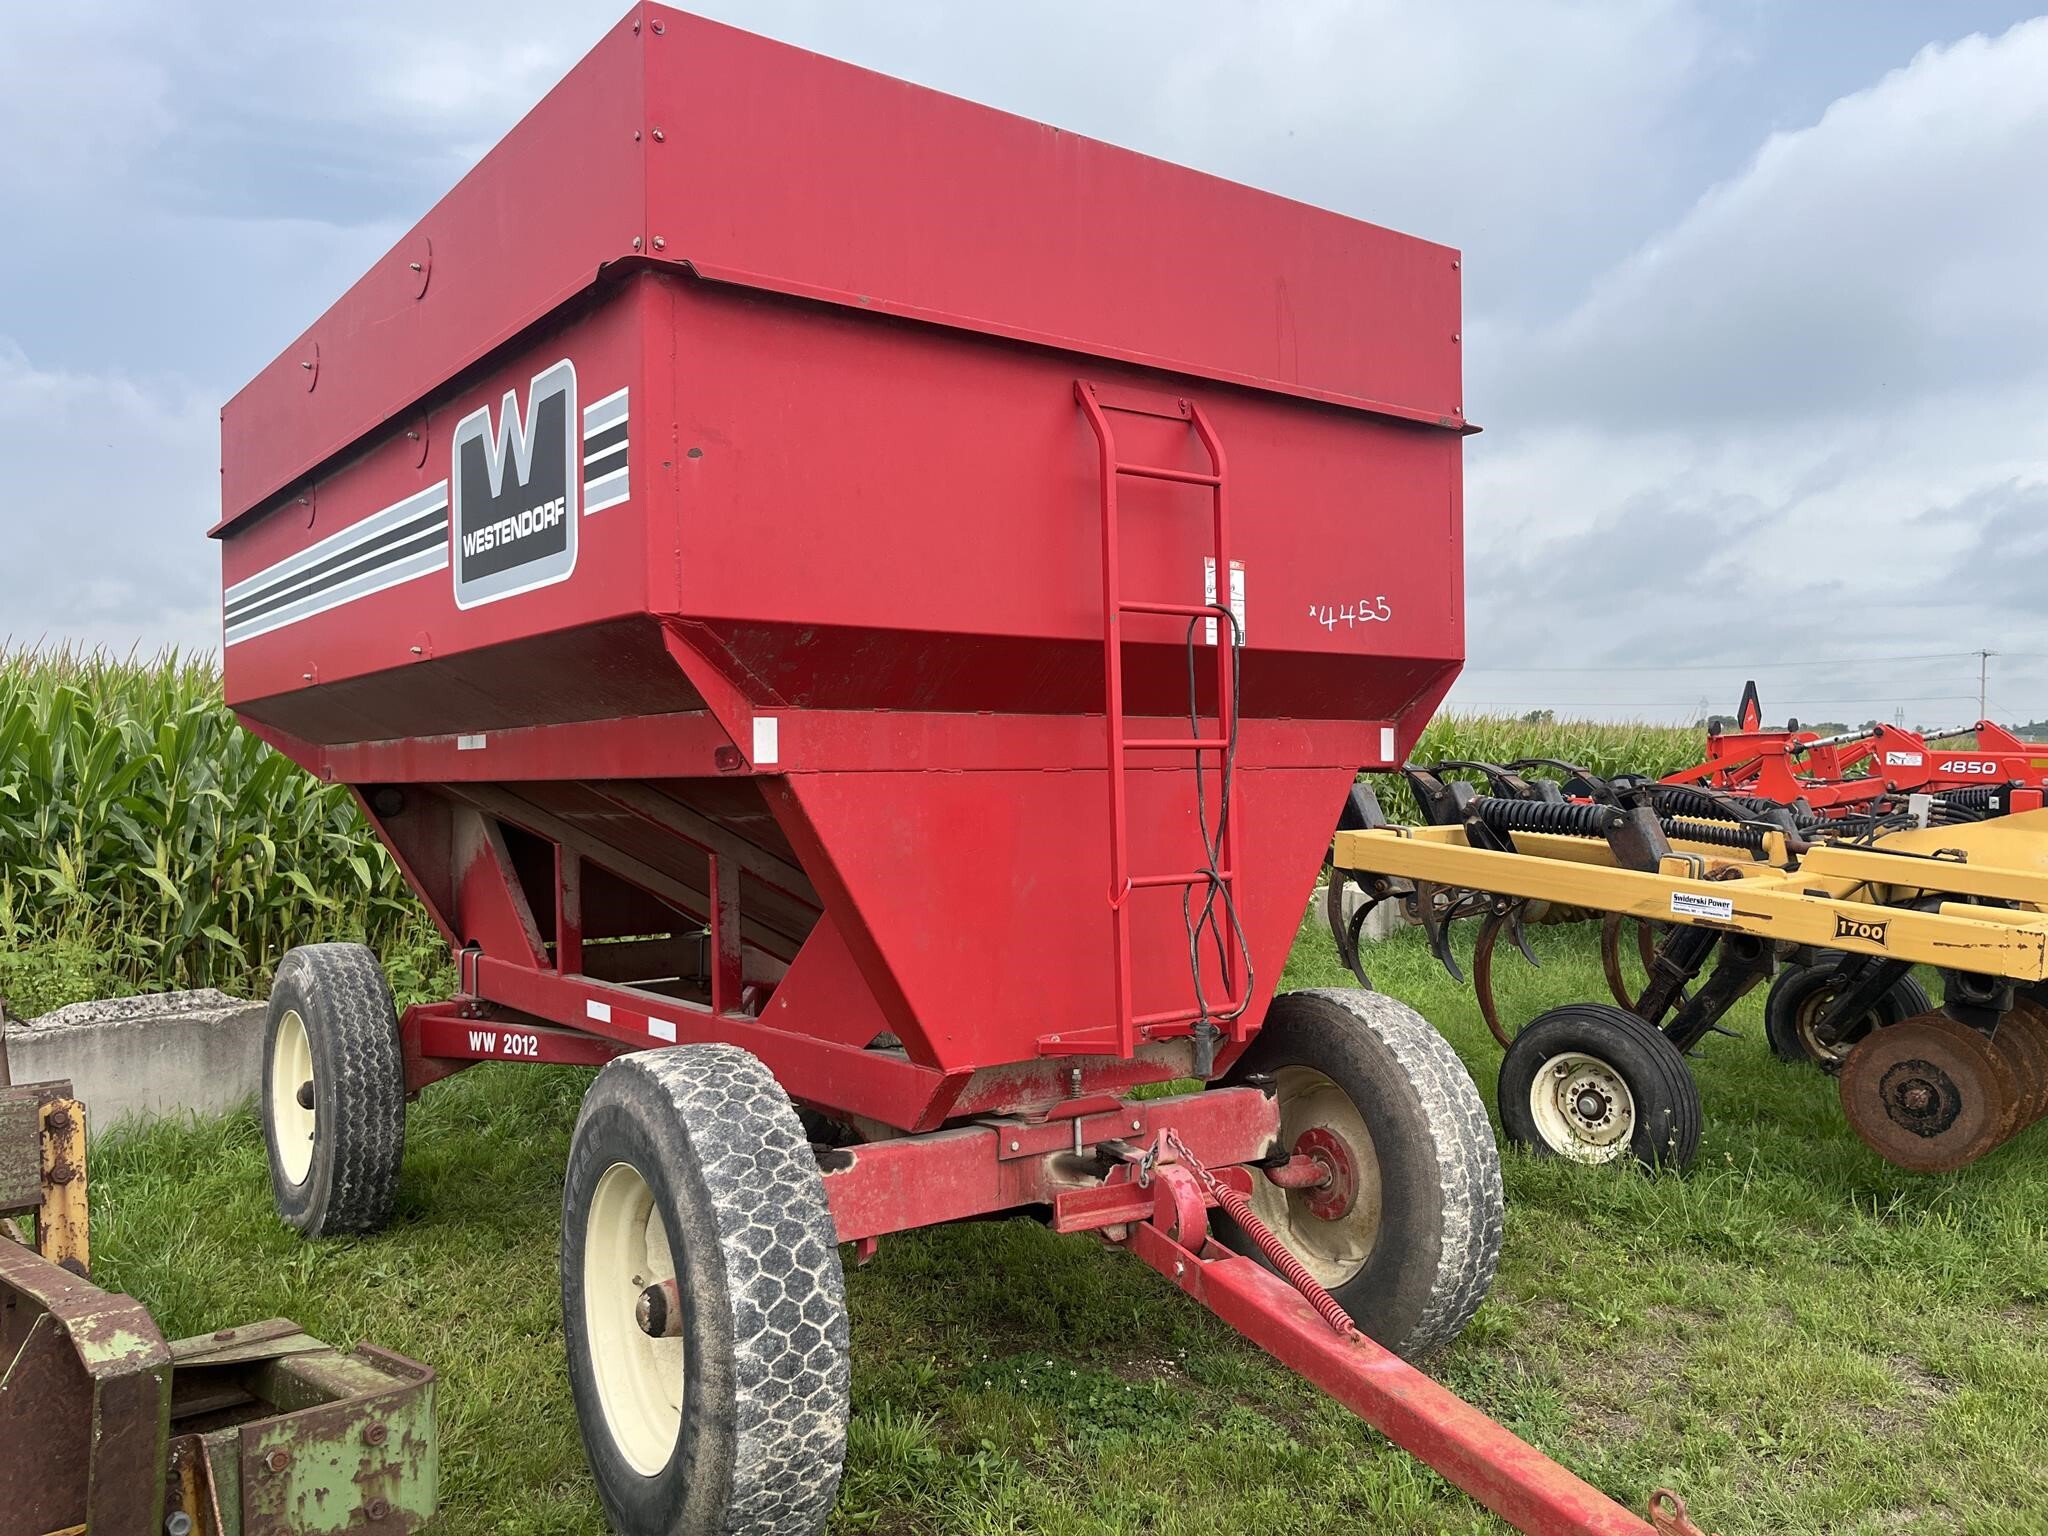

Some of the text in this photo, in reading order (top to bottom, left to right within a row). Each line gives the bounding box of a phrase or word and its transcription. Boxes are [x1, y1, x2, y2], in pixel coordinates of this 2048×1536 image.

[463, 496, 565, 557] WESTENDORF
[1938, 760, 1997, 775] 4850
[1673, 893, 1731, 909] Swiderski Power
[1839, 919, 1883, 940] 1700
[469, 1030, 538, 1056] WW 2012
